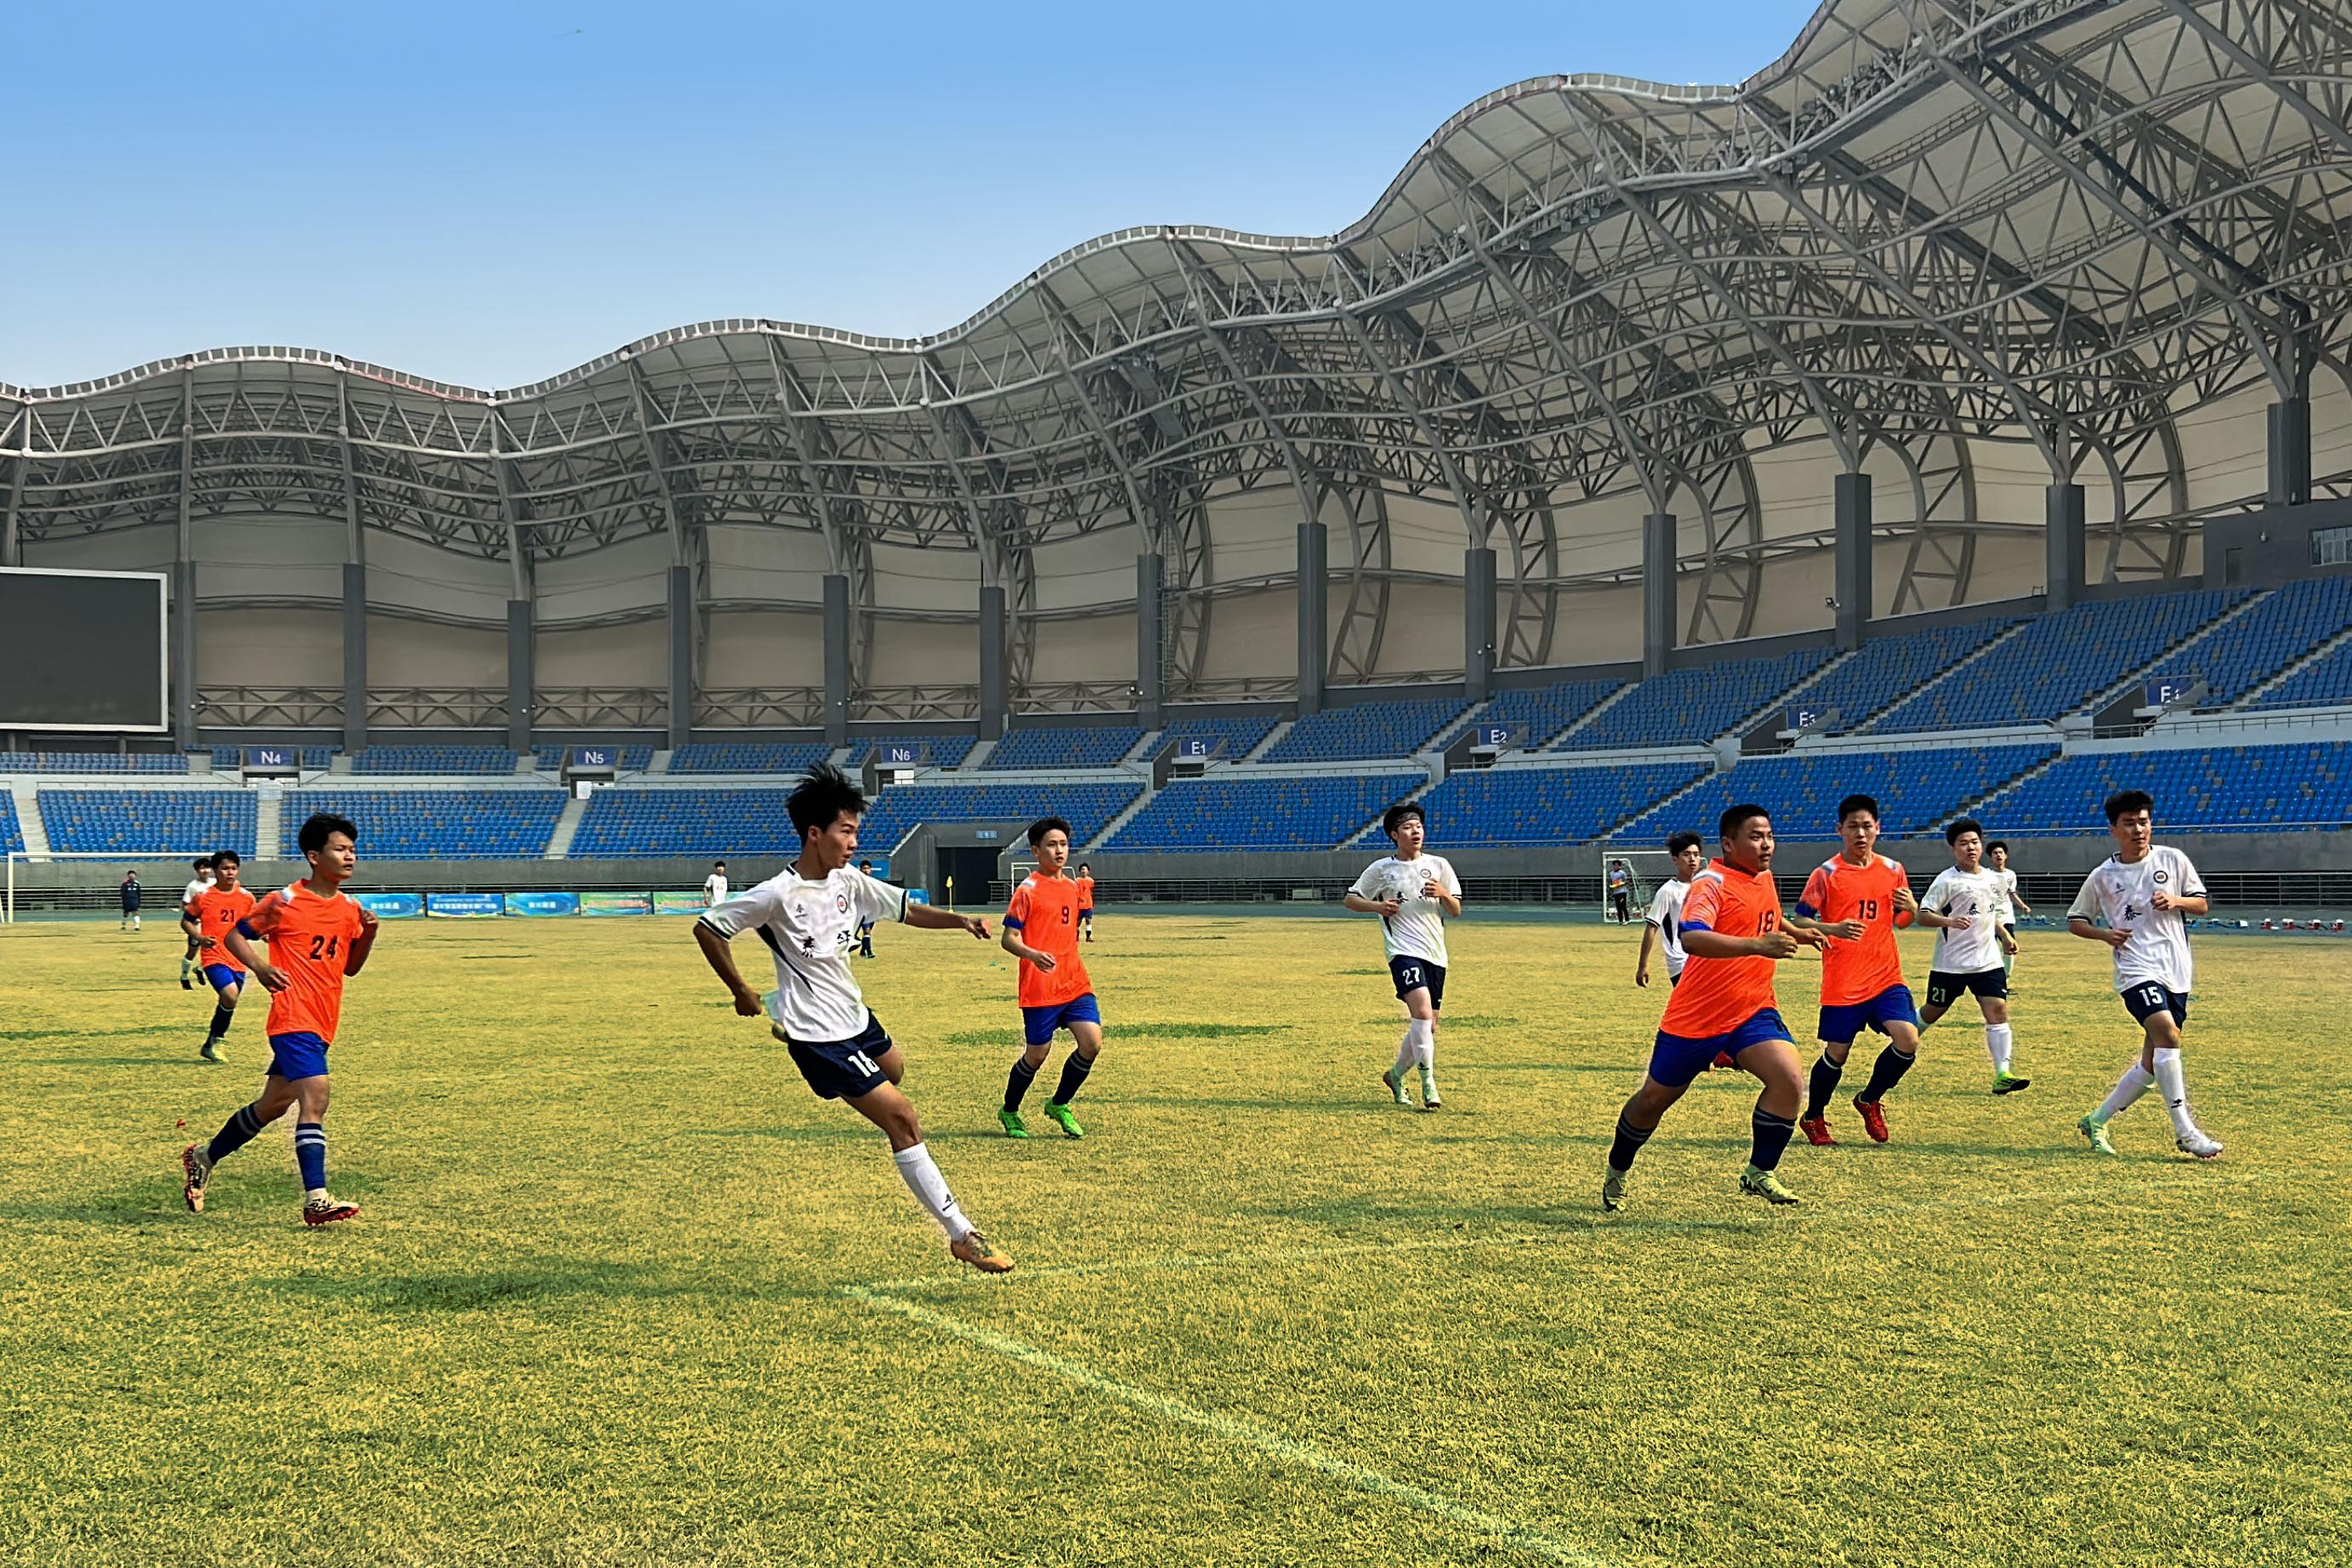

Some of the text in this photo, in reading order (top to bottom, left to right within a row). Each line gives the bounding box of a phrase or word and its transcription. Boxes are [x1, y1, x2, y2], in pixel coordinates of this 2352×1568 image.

[1491, 730, 1507, 743] E2
[892, 748, 911, 761] N6
[1191, 741, 1206, 754] E1
[261, 751, 281, 764] N4
[585, 751, 604, 764] N5
[221, 909, 235, 923] 21
[1062, 906, 1069, 924] 9
[1859, 900, 1877, 919] 19
[310, 935, 338, 960] 24
[1402, 967, 1420, 986] 27
[1932, 986, 1946, 1003] 21
[2139, 986, 2163, 1007] 15
[848, 1050, 880, 1077] 16
